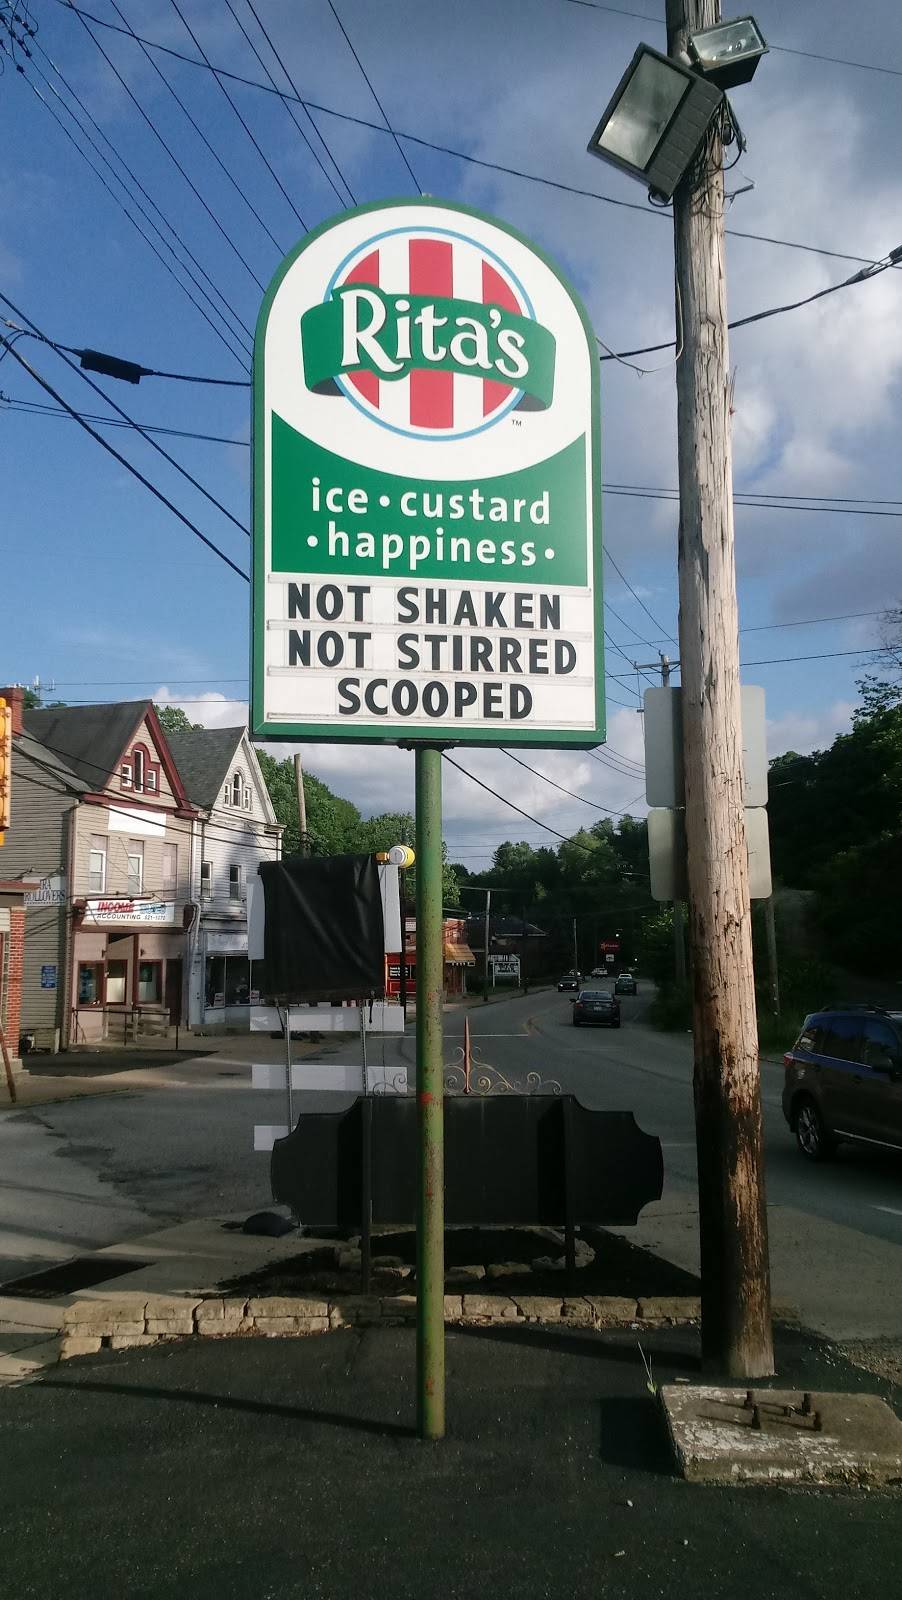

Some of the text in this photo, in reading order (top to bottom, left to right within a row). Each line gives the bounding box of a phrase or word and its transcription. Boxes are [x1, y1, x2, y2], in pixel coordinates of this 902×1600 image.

[340, 288, 529, 379] Rita's
[312, 476, 552, 526] ice custard
[329, 520, 537, 571] happiness
[288, 583, 561, 630] NOT SHAKEN
[288, 630, 577, 675] NOT STIRRED
[338, 678, 533, 720] SCOOPED
[96, 913, 142, 921] ACCOUNTING
[97, 901, 134, 914] INCOME
